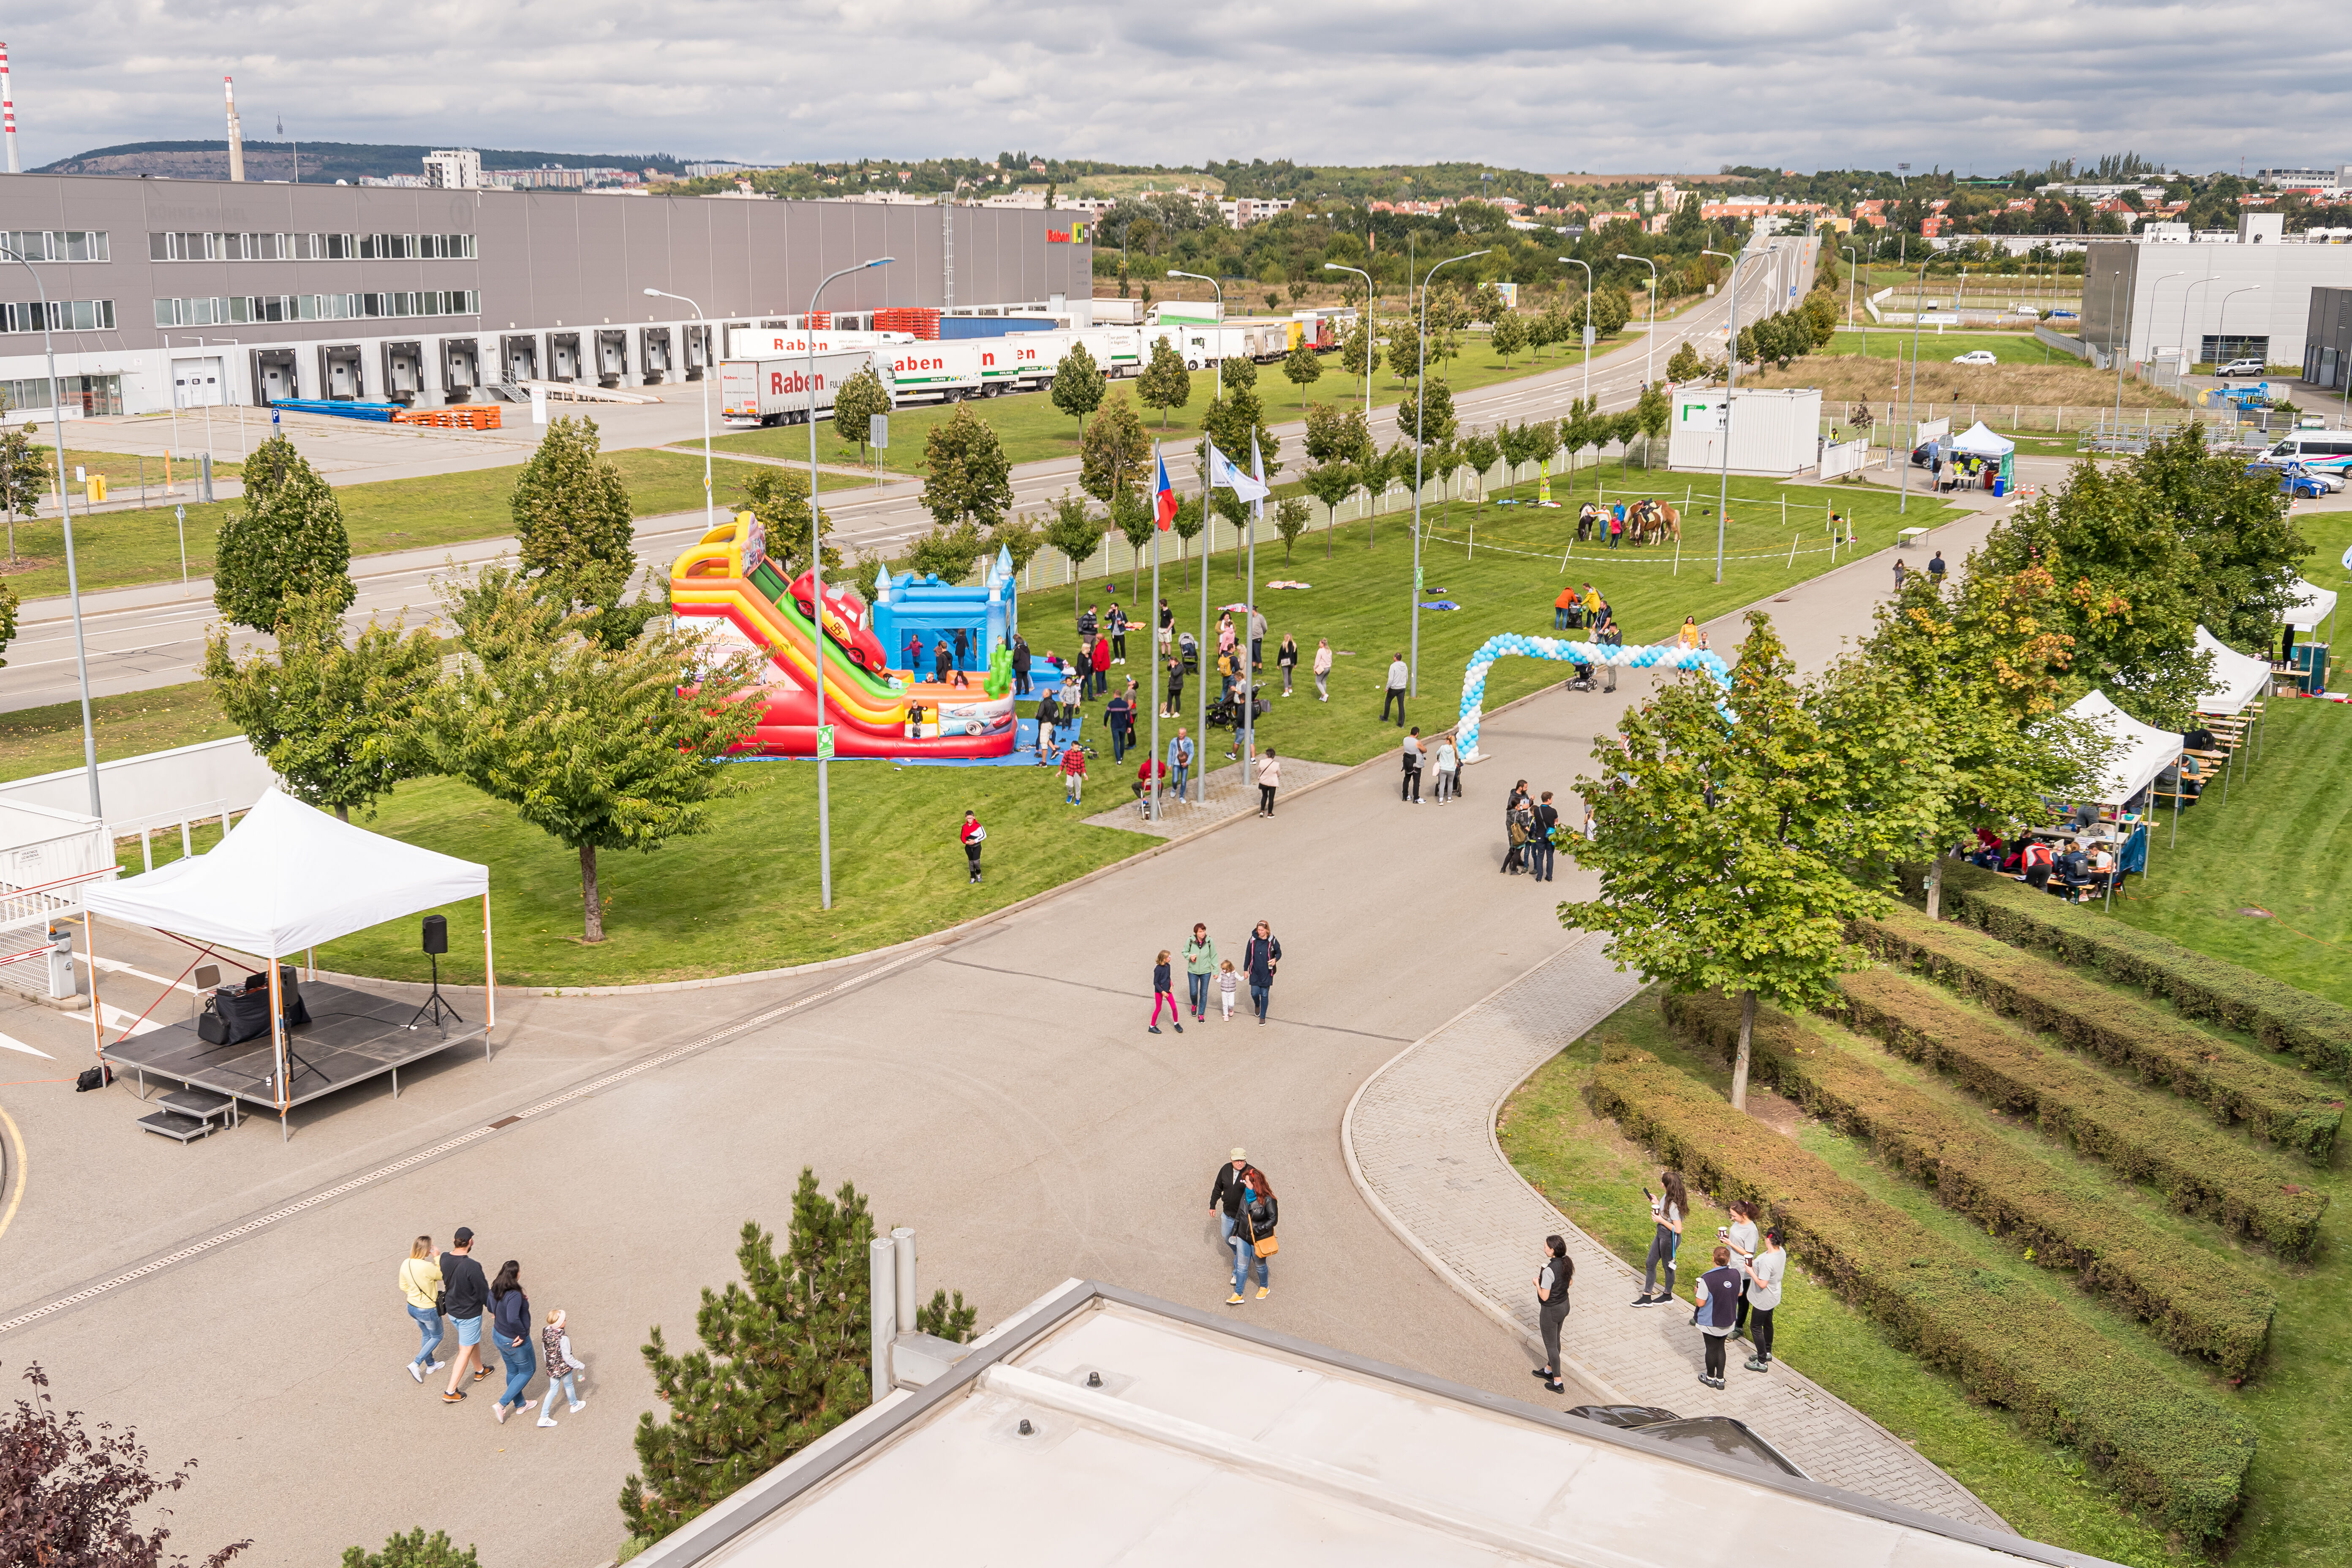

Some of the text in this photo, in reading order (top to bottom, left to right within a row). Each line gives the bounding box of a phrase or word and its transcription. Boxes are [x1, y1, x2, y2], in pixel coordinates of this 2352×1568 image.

[1047, 229, 1070, 242] Raben
[1084, 229, 1089, 238] D1
[774, 338, 828, 351] Raben
[895, 356, 943, 371] aben
[771, 370, 824, 395] Raben
[272, 410, 278, 420] P
[830, 622, 844, 636] 95
